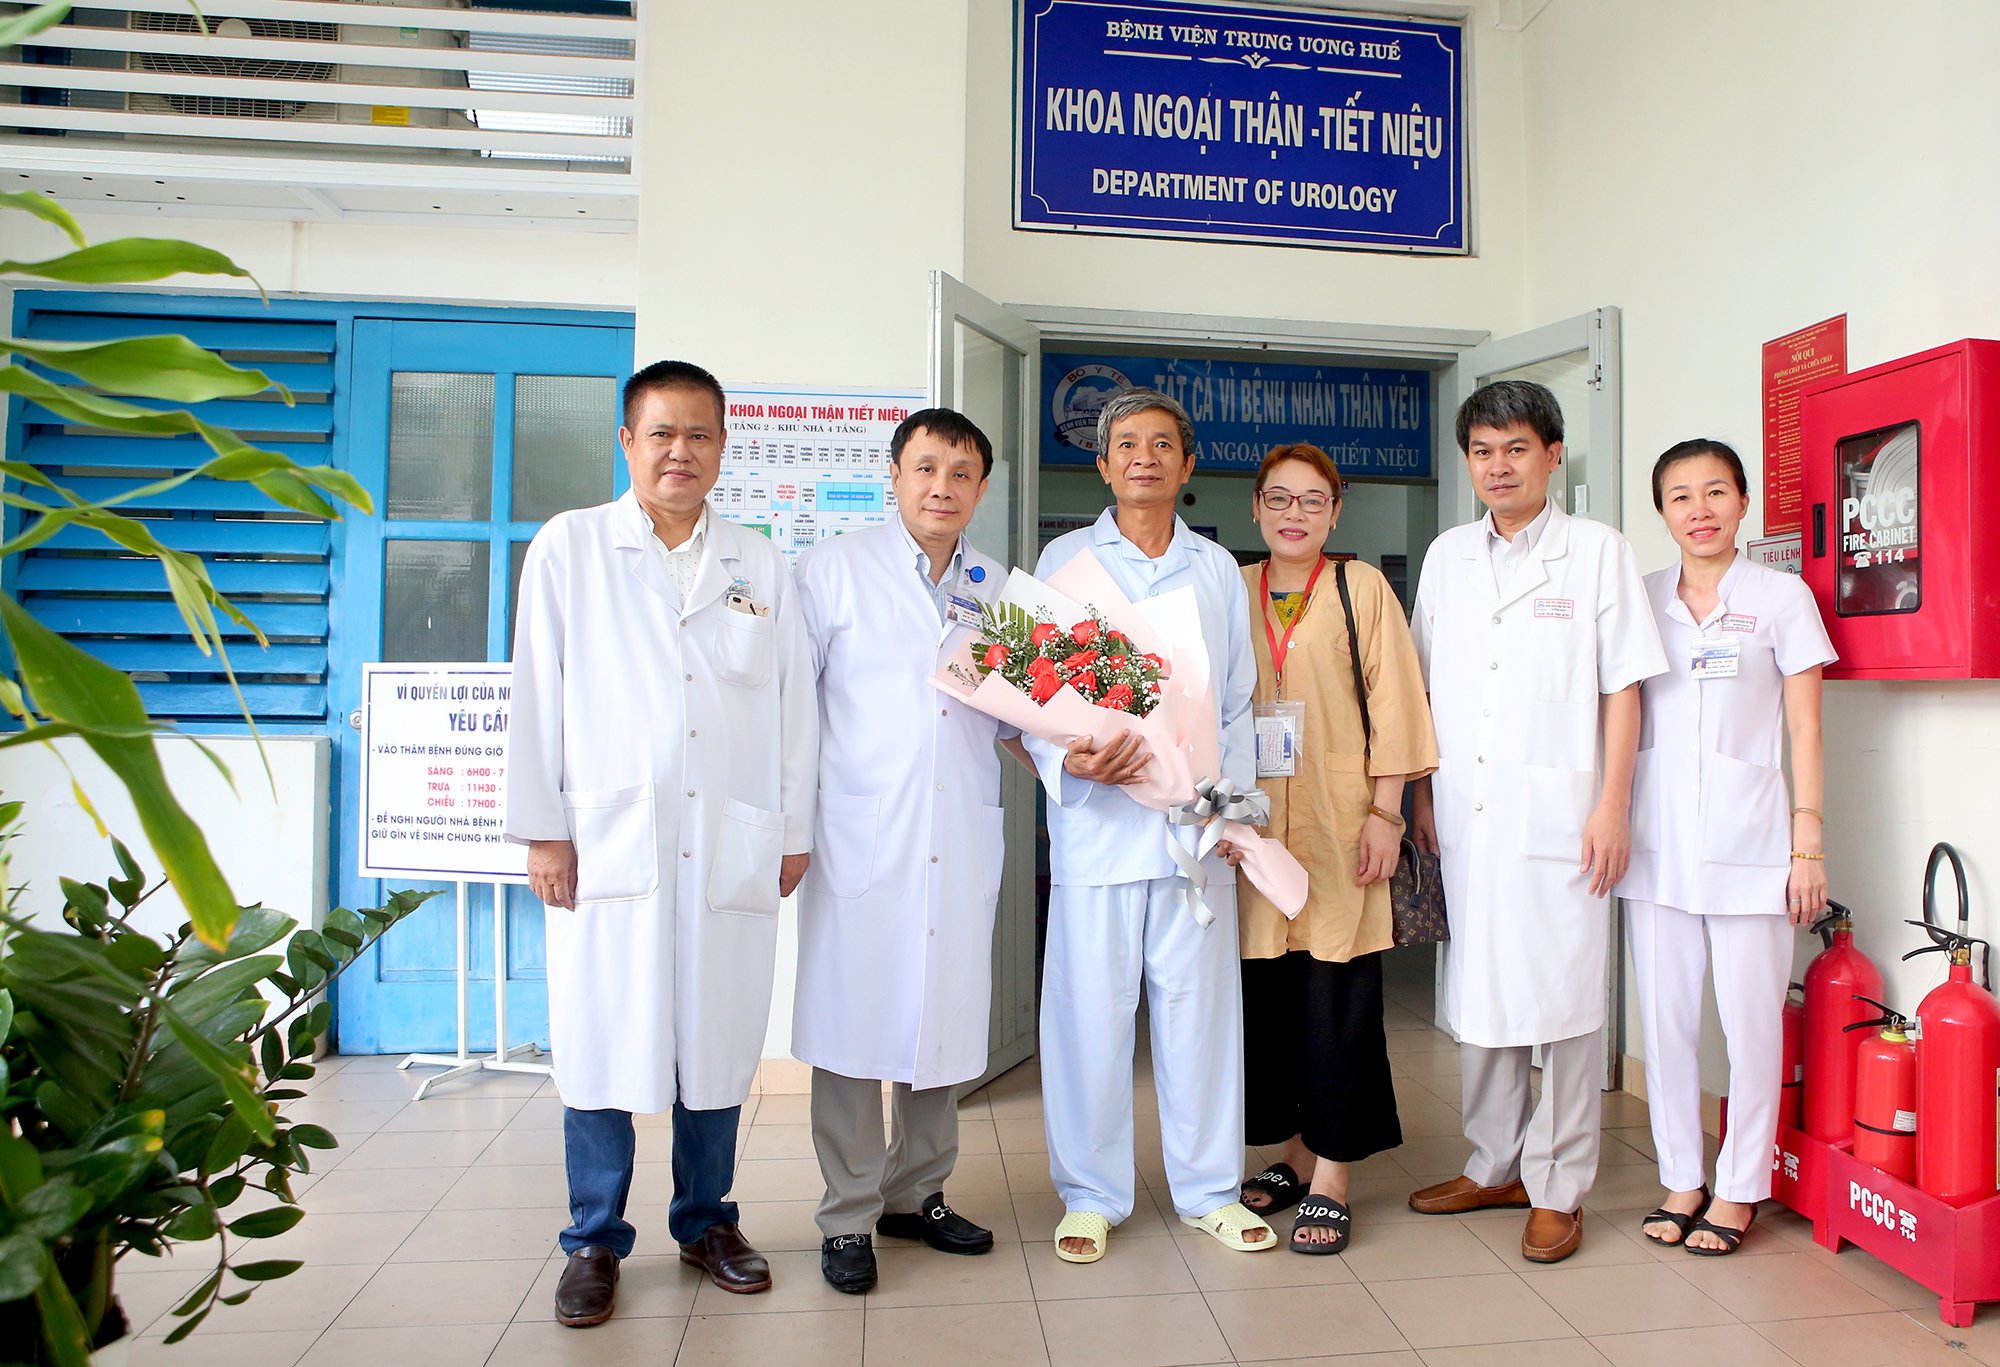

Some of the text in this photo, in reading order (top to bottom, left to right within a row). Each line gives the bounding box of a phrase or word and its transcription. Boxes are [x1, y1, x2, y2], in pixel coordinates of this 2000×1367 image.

[1107, 19, 1163, 42] BỆNH
[1170, 23, 1217, 46] VIỆN
[1224, 29, 1292, 52] TRUNG
[1359, 39, 1401, 61] HUẾ
[1046, 87, 1125, 136] KHOA
[1133, 92, 1221, 155] NGOẠI
[1230, 91, 1303, 159] THẬN
[1381, 103, 1442, 170] NIỆU
[1093, 168, 1397, 214] DEPARTMENT OF UROLOGY
[1192, 360, 1214, 422] CẢ
[1219, 366, 1235, 422] VÌ
[1241, 367, 1286, 433] BỆNH
[1291, 370, 1335, 427] NHÂN
[1340, 372, 1383, 429] THÂN
[1388, 374, 1420, 430] YÊU
[730, 403, 909, 424] KHOA NGOẠI THẬN TIẾT NIỆU
[778, 424, 800, 432] KHU
[803, 423, 824, 433] NHÀ
[1210, 442, 1270, 466] NGOẠI
[1375, 443, 1420, 471] NIỆU
[1843, 487, 1915, 533] PCCC
[1843, 526, 1915, 552] FIRE CABINET
[1781, 545, 1801, 563] LỆNH
[1876, 548, 1905, 565] 114
[397, 683, 407, 700] VÌ
[410, 681, 448, 702] QUYỀN
[450, 684, 468, 703] LỢI
[472, 681, 495, 701] CỦA
[449, 709, 477, 732] YÊU
[378, 744, 398, 754] VÀO
[400, 744, 425, 755] THĂM
[428, 744, 452, 758] BỆNH
[455, 744, 482, 756] ĐÚNG
[485, 745, 503, 757] GIỜ
[428, 765, 453, 776] SÁNG
[467, 768, 490, 777] 6H00
[428, 782, 450, 791] TRƯA
[467, 783, 496, 793] 11H30
[428, 794, 455, 808] CHIỀU
[467, 799, 496, 809] 17H00
[390, 815, 414, 827] NGHỊ
[416, 815, 447, 826] NGƯỜI
[449, 815, 470, 827] NHÀ
[472, 816, 497, 830] BỆNH
[371, 829, 388, 839] GIỮ
[390, 829, 407, 840] GÌN
[409, 830, 420, 843] VỆ
[423, 831, 445, 841] SINH
[447, 833, 482, 843] CHUNG
[484, 834, 500, 843] KHI
[1255, 1171, 1290, 1187] uper
[1784, 1167, 1798, 1182] 114
[1296, 1202, 1349, 1221] Super
[1850, 1180, 1896, 1231] PCCC
[1900, 1226, 1916, 1242] 114
